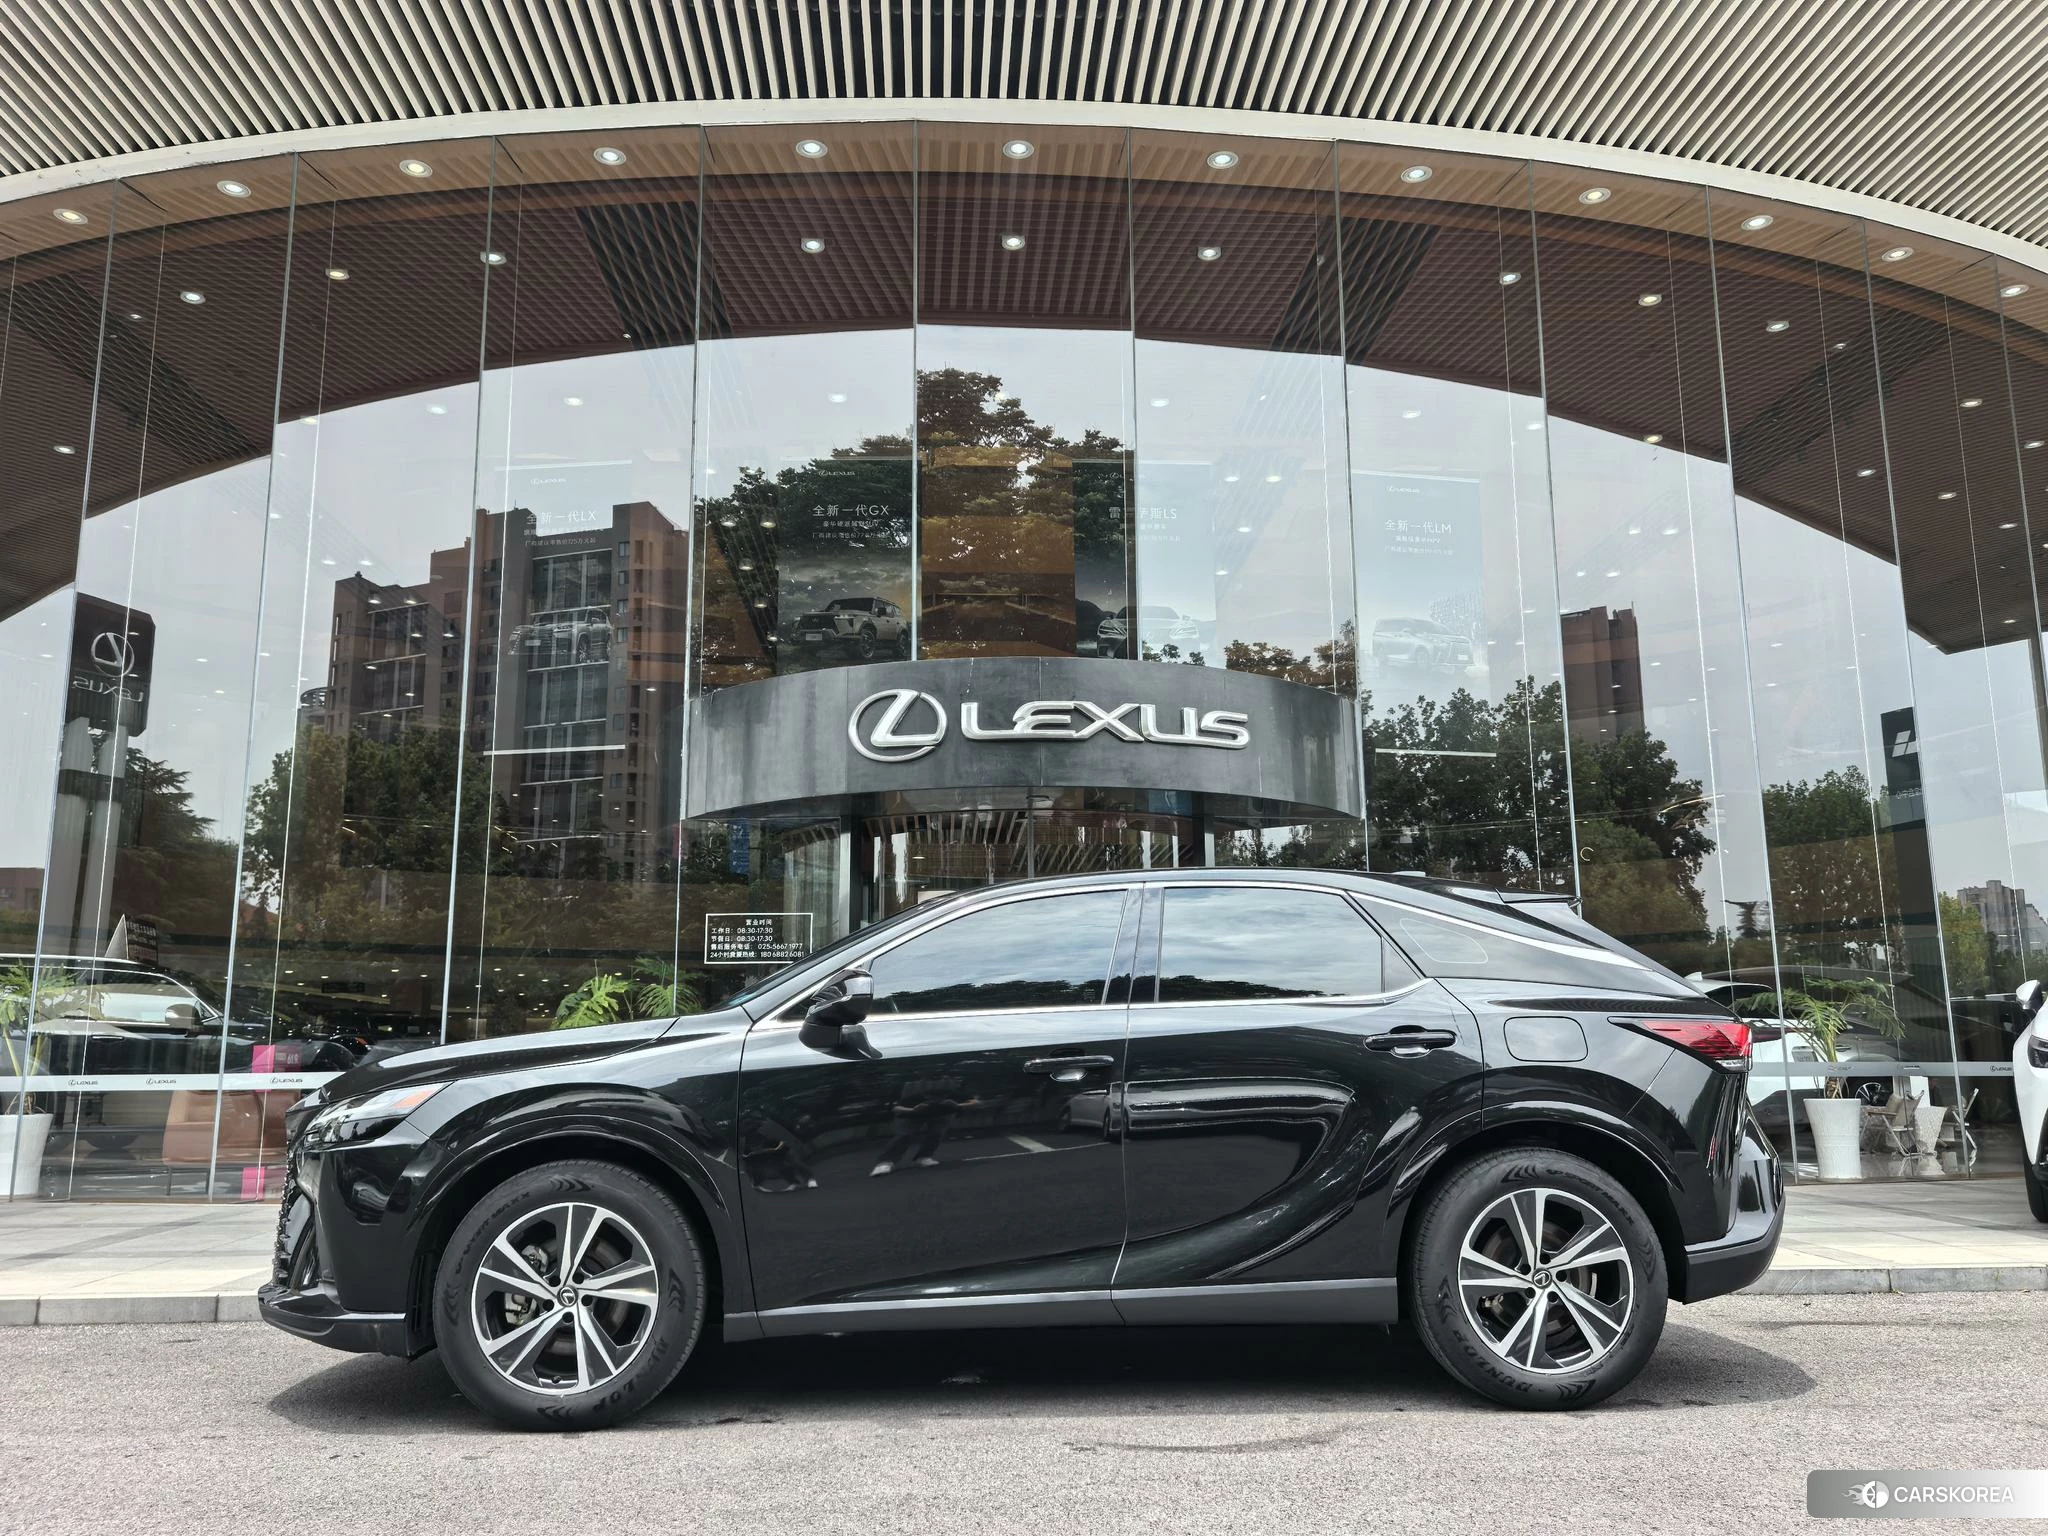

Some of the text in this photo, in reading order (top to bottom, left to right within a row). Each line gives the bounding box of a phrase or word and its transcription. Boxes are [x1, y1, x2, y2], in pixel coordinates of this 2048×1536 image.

[812, 504, 889, 517] 全新一代GX
[960, 700, 1251, 750] LEXUS
